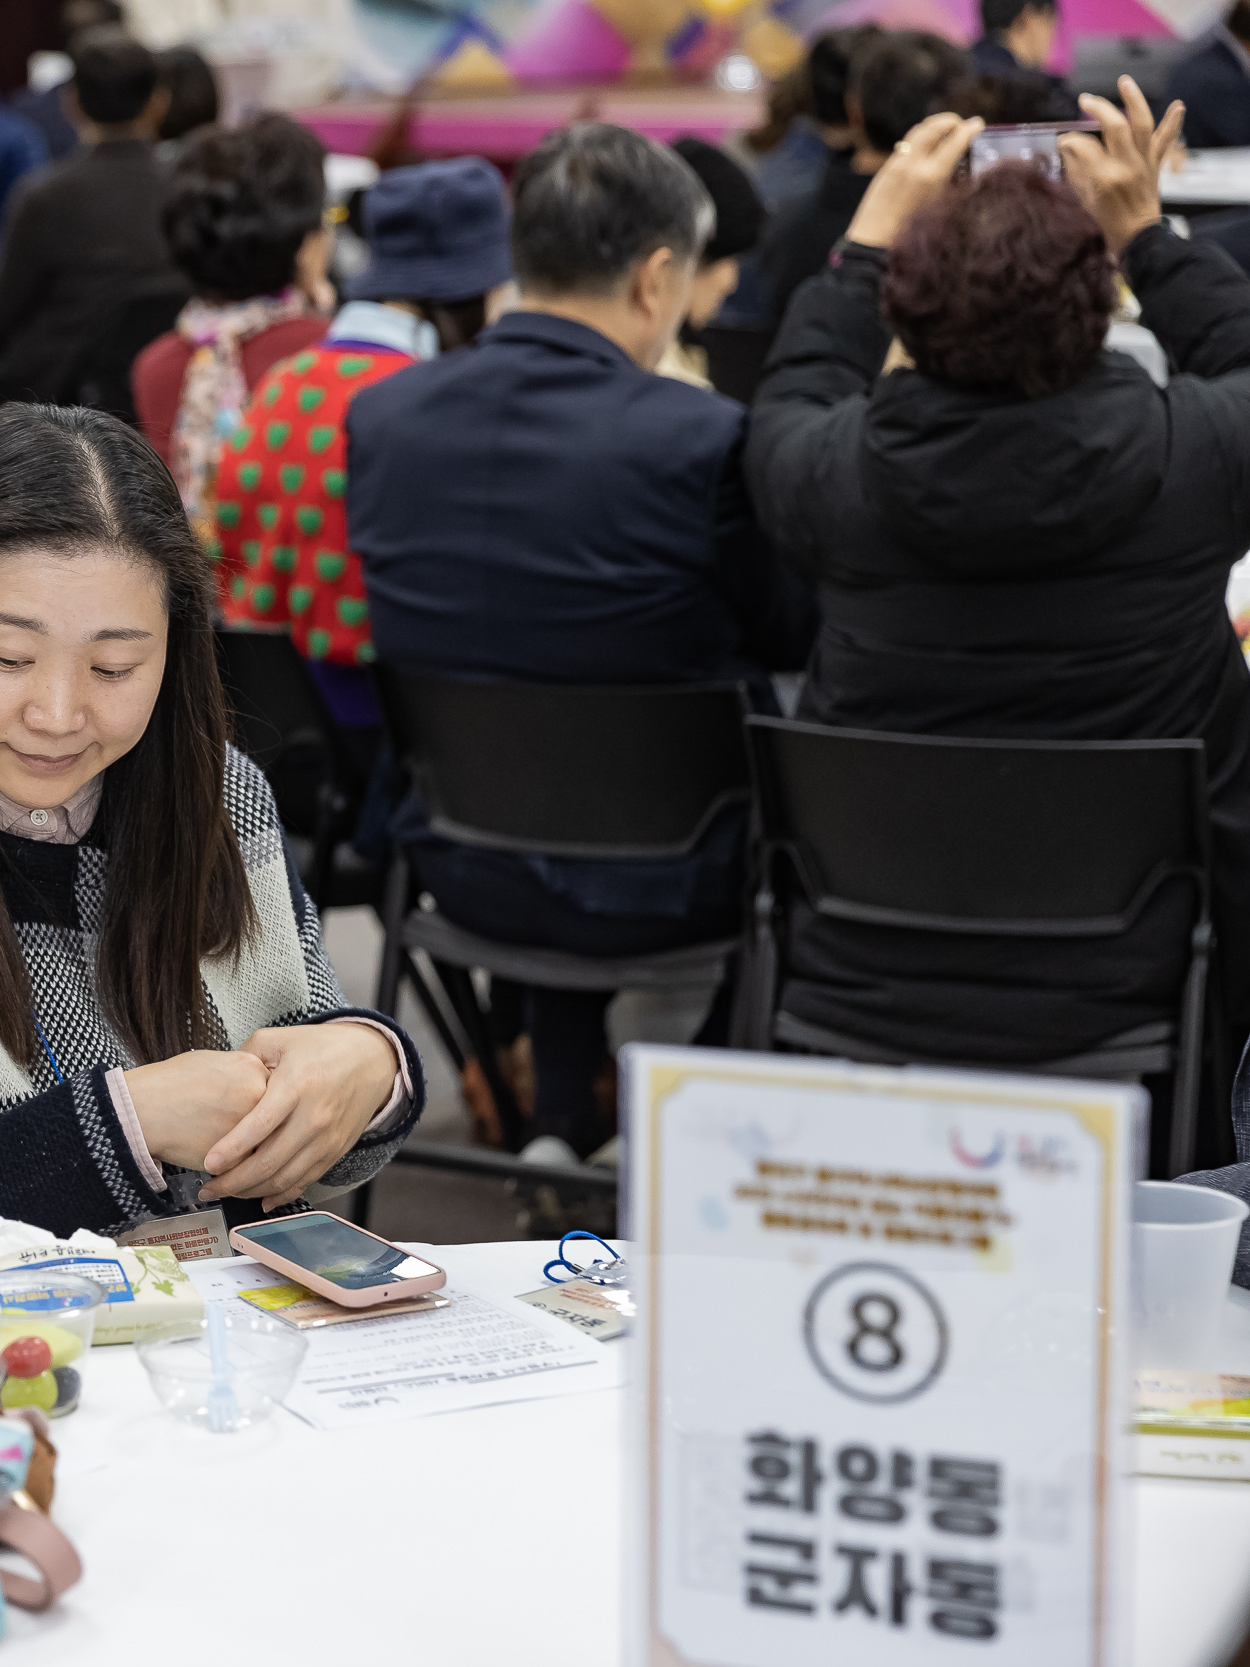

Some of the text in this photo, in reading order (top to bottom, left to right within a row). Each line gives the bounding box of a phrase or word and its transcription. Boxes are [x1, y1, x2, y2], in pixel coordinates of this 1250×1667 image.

[847, 1291, 905, 1374] 8
[742, 1425, 1005, 1540] 화양동
[741, 1529, 1002, 1643] 군자동
